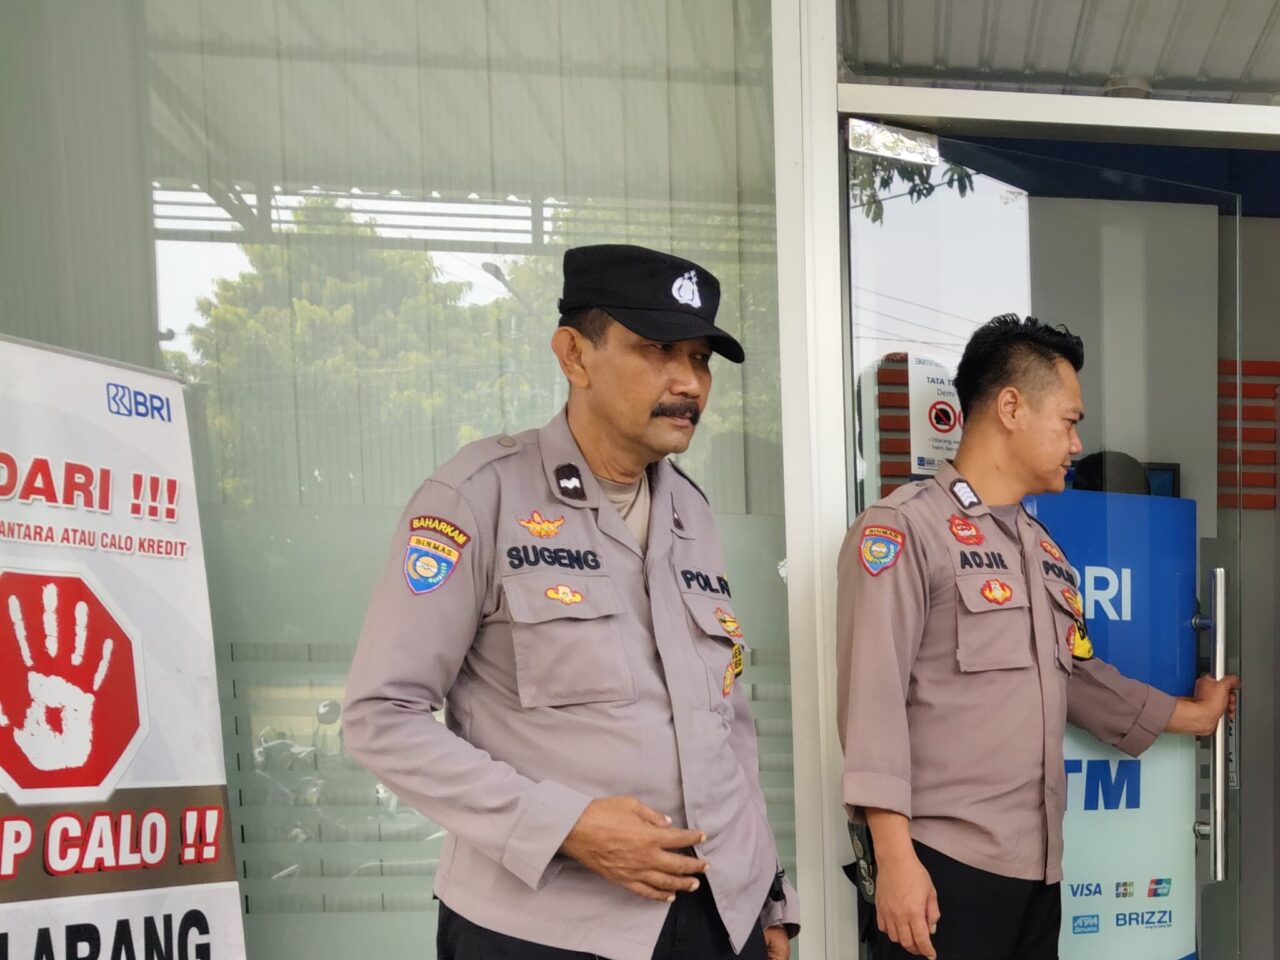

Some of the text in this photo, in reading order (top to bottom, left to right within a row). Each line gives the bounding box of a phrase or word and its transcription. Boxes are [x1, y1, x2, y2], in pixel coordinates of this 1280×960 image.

[926, 376, 945, 386] TATA
[937, 388, 955, 398] Demi
[133, 391, 172, 423] BRI
[130, 473, 177, 520] !!!
[61, 527, 96, 547] ATAU
[100, 532, 133, 551] CALO
[138, 537, 187, 557] KREDIT
[412, 517, 468, 545] BAHARKAM
[507, 545, 600, 570] SUGENG
[960, 550, 1008, 570] ADJIE
[1071, 566, 1132, 621] RI
[1, 810, 219, 875] P CALO !!
[1068, 883, 1102, 897] VISA
[1115, 910, 1172, 926] BRIZZI
